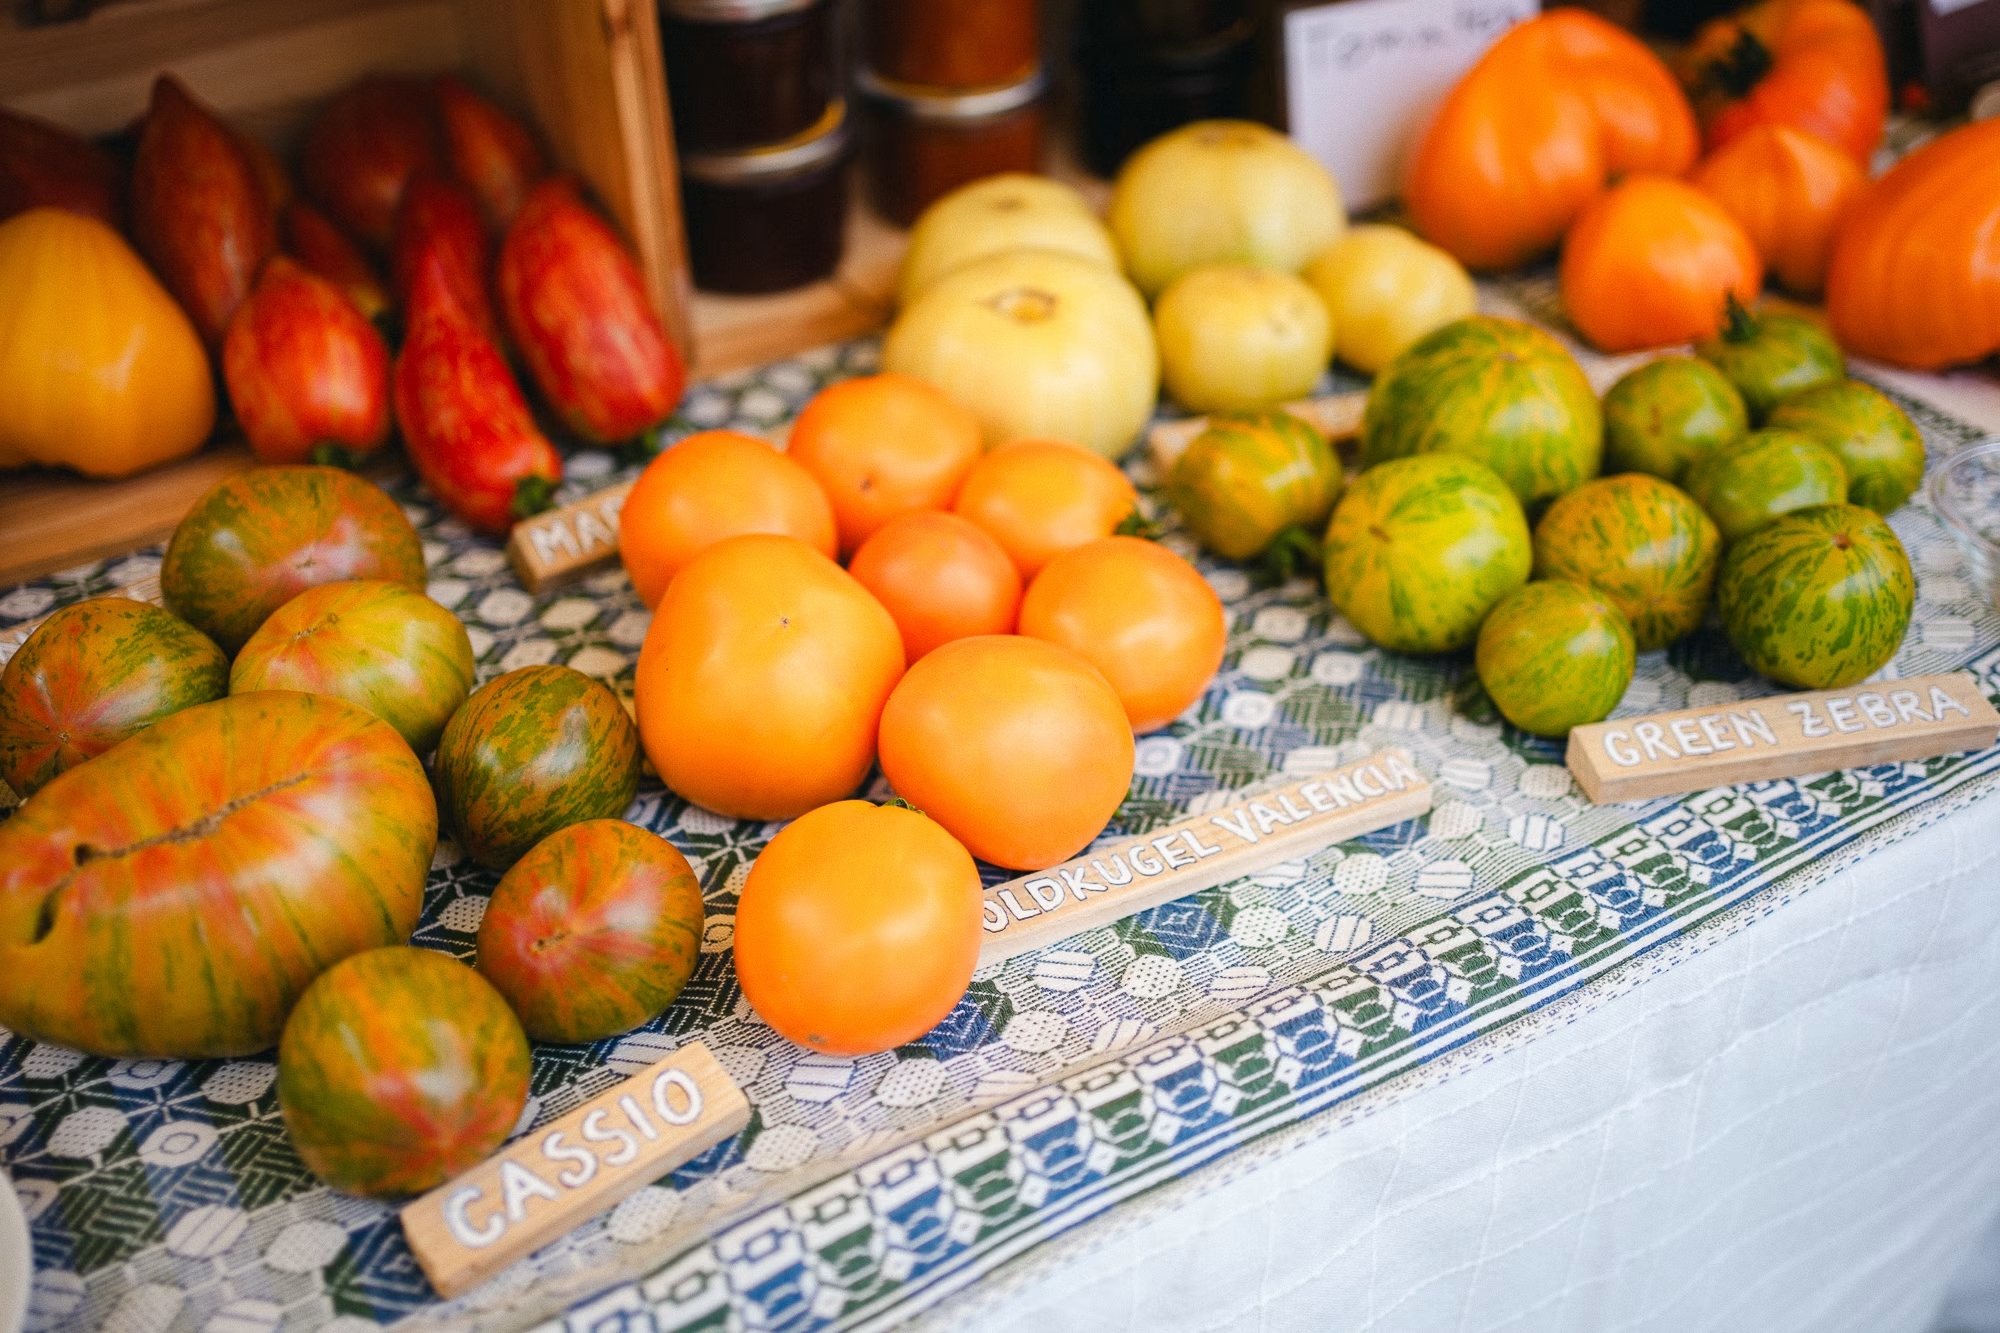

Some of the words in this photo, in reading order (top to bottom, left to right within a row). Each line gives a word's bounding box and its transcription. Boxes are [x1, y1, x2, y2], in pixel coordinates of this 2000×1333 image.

[1603, 708, 1778, 767] GREEN
[1788, 686, 1970, 738] ZEBRA
[1211, 755, 1419, 844] VALENCIA
[444, 1068, 704, 1248] CASSIO
